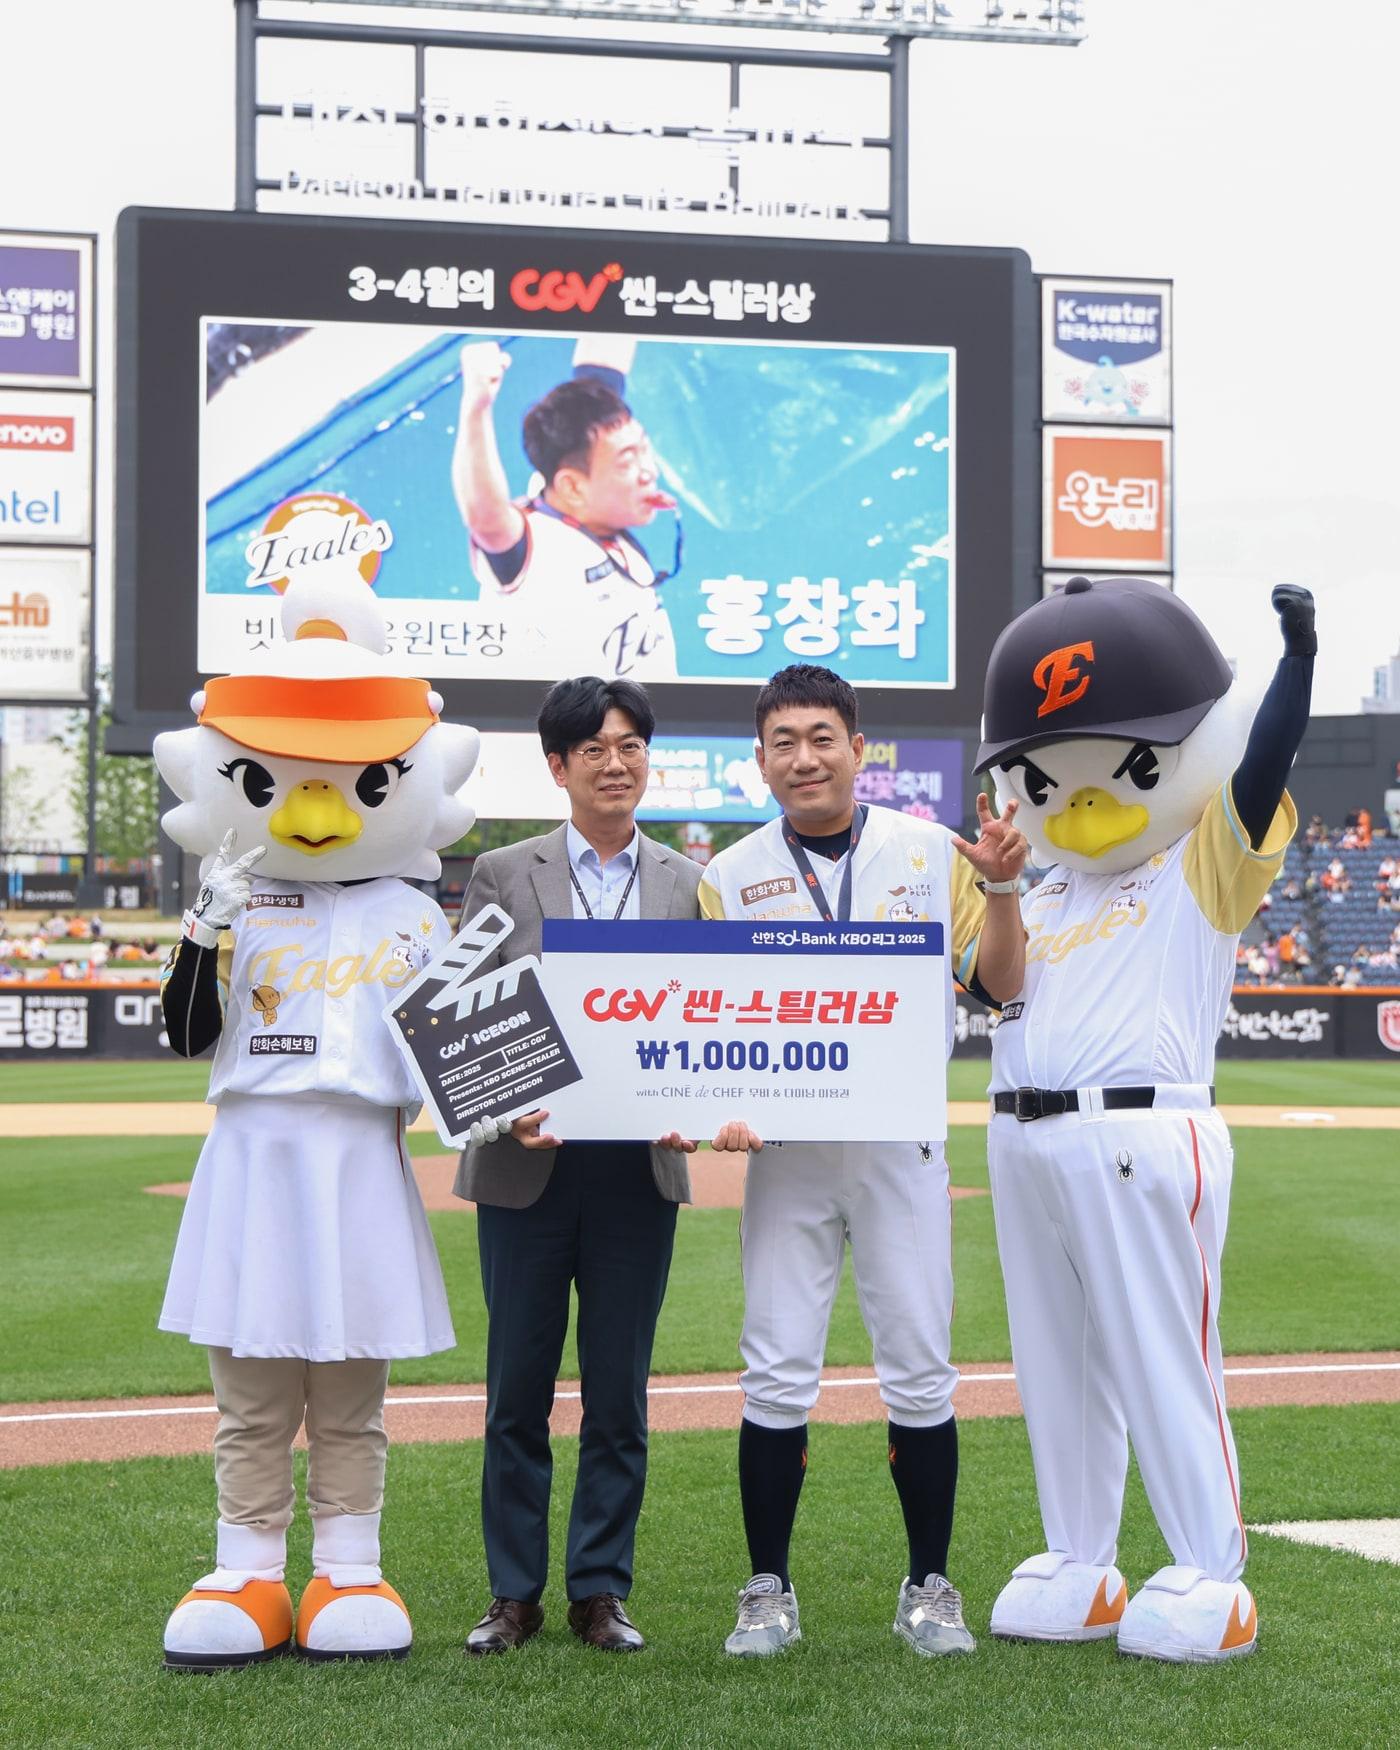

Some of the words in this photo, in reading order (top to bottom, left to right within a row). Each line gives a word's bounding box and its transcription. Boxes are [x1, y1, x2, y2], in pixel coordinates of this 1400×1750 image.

[348, 265, 495, 311] 3-4월의
[509, 268, 607, 313] CGV
[619, 275, 816, 324] 씬-스틸러상
[1057, 298, 1160, 326] K-water
[696, 574, 926, 660] 홍창화
[1031, 639, 1095, 720] E
[251, 895, 299, 906] 한화생명
[745, 880, 792, 901] 한화생명
[751, 932, 775, 945] 신한
[801, 932, 837, 945] Bank
[898, 934, 926, 944] 2025
[582, 987, 668, 1023] CGV
[682, 989, 900, 1025] 씬-스틸러상
[252, 1037, 315, 1052] 한화손해보험
[439, 1037, 467, 1059] CGV
[472, 1010, 531, 1046] ICECON
[505, 1042, 530, 1057] TITLE:
[530, 1033, 547, 1046] CGV
[635, 1039, 849, 1074] ₩1,000,000
[449, 1084, 483, 1103] Presents:
[483, 1075, 501, 1089] KBO
[501, 1047, 561, 1080] SCENE-STEALER
[636, 1086, 659, 1097] with
[695, 1084, 710, 1098] de
[712, 1087, 745, 1098] CHEF
[773, 1088, 781, 1098] &
[456, 1098, 497, 1120] DIRECTOR:
[497, 1089, 513, 1102] CGV
[514, 1076, 544, 1094] ICECON
